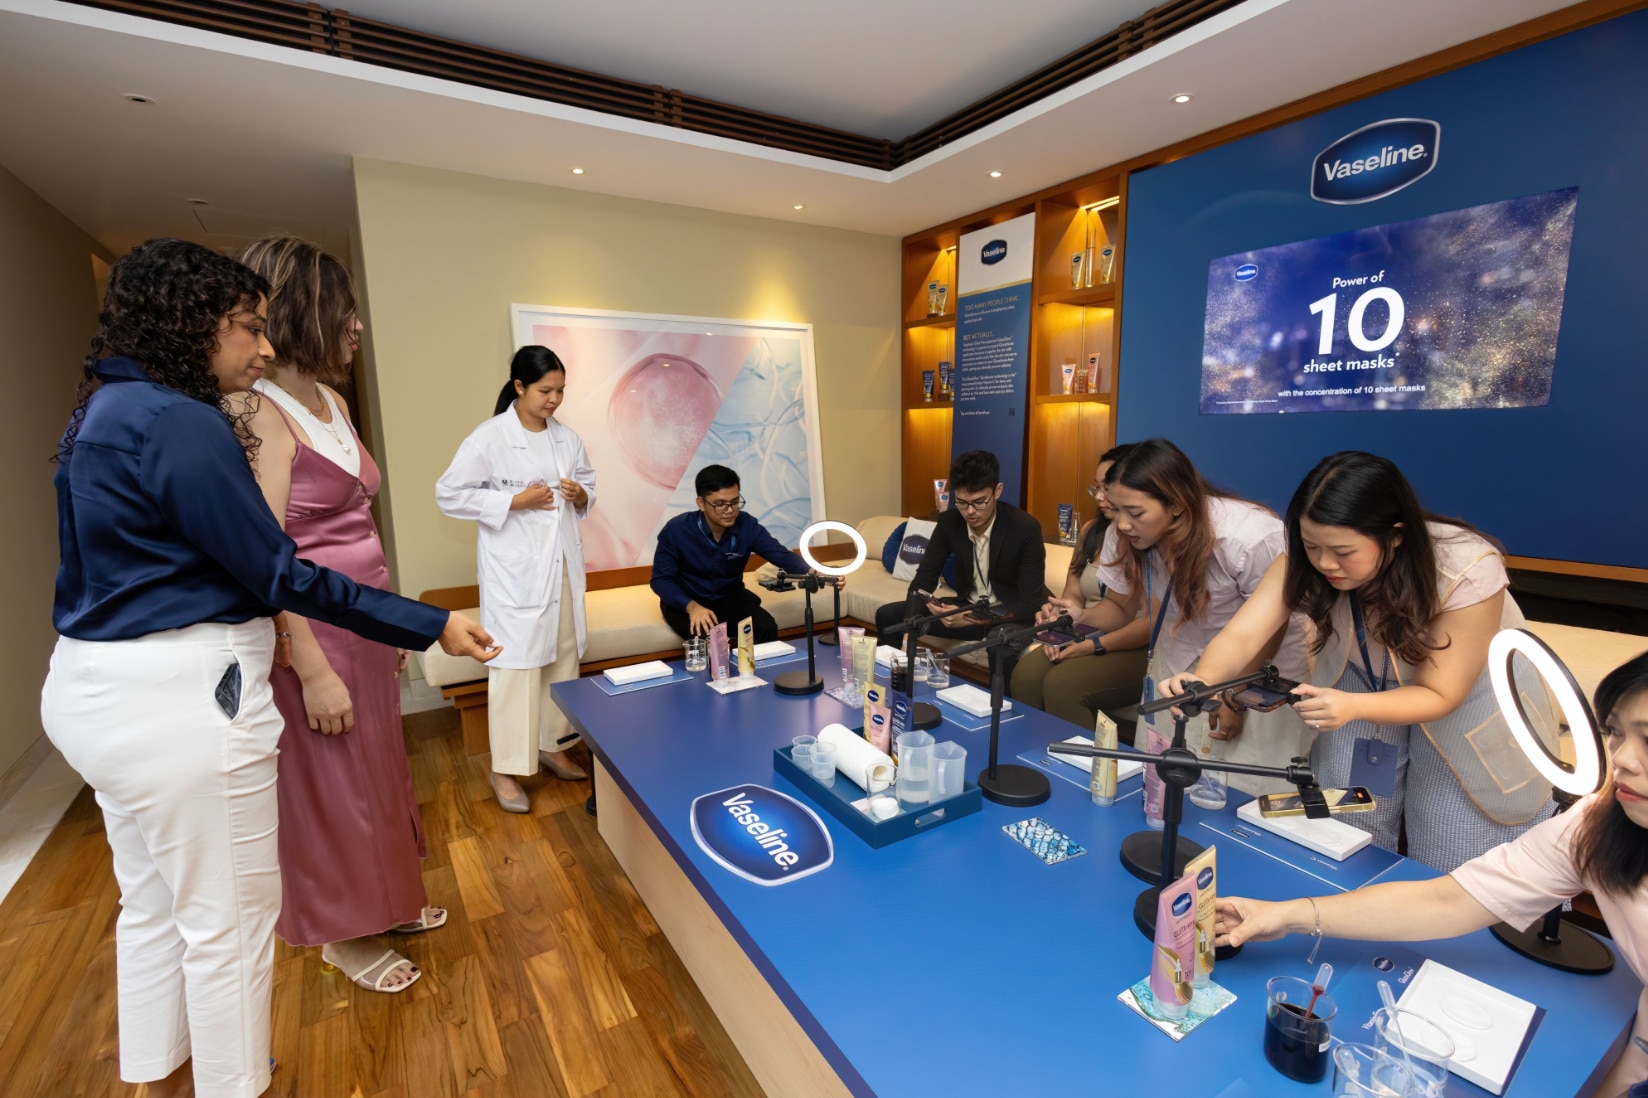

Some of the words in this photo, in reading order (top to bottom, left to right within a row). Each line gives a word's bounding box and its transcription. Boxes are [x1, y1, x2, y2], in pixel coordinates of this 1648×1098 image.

[1324, 144, 1425, 181] Vaseline
[1332, 277, 1368, 289] Power
[1370, 270, 1385, 283] of
[1309, 286, 1405, 355] 10
[1303, 359, 1342, 373] sheet
[1305, 387, 1352, 397] concentration
[1364, 386, 1373, 394] 10
[1375, 385, 1397, 393] sheet
[1399, 384, 1425, 392] masks
[723, 792, 799, 867] Vaseline
